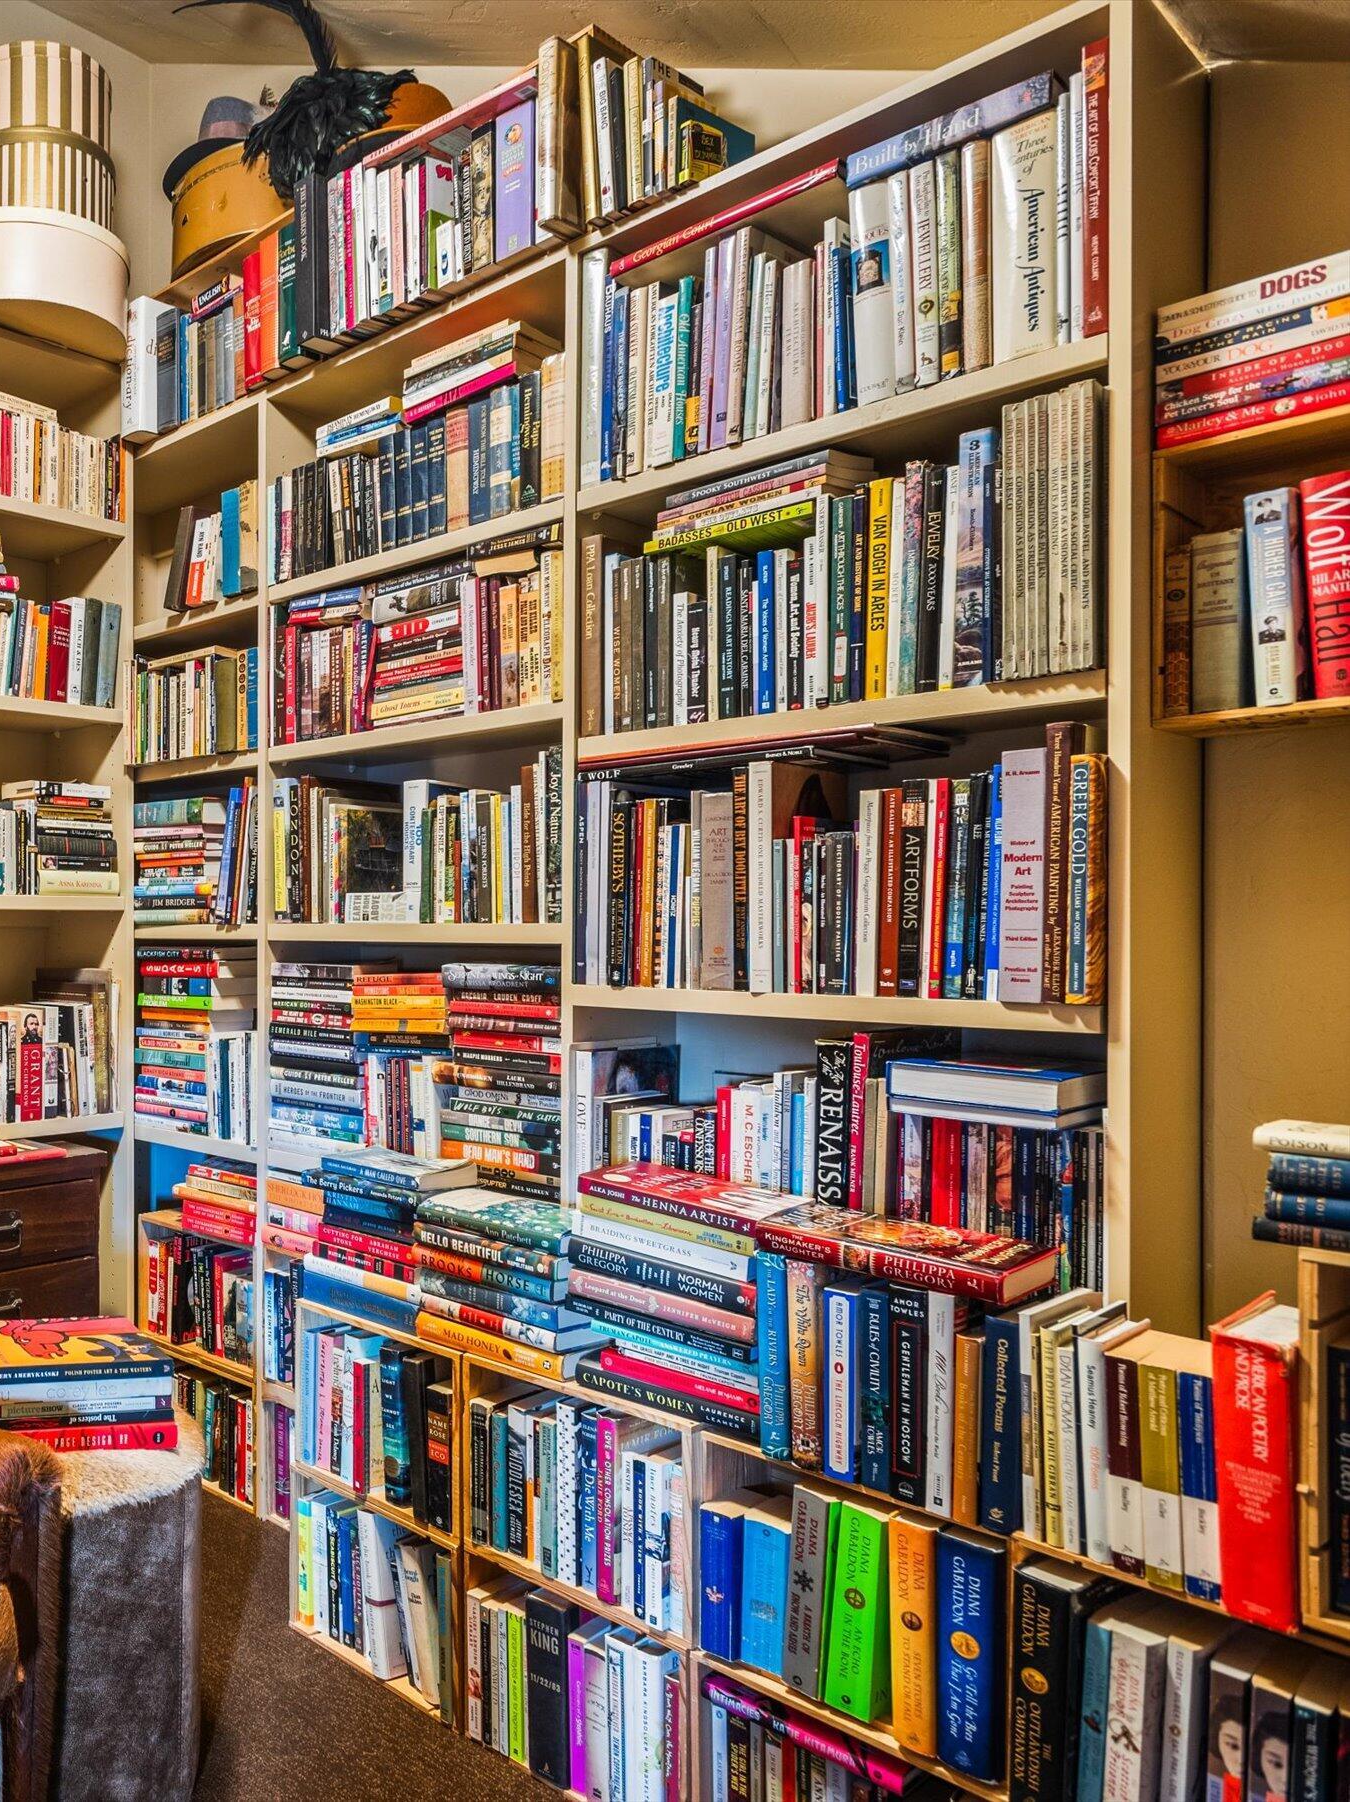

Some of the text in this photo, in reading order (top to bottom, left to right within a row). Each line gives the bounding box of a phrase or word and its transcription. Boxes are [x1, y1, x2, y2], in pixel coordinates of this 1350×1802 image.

[599, 91, 608, 130] BIG BANG
[854, 109, 980, 176] Built by Hand
[1016, 136, 1047, 153] Three
[1022, 165, 1034, 175] of
[632, 215, 715, 263] Georgian Court
[916, 215, 932, 292] JEWELLERY
[1015, 180, 1045, 332] American Antiques
[1260, 264, 1327, 299] DOGS
[656, 304, 675, 394] Architecture
[1211, 364, 1261, 381] INSIDE
[1269, 356, 1286, 365] OF
[1311, 341, 1345, 355] DOG
[1164, 382, 1261, 411] Chicken Soup for the
[1164, 396, 1238, 419] Pet Lover's Soul
[1175, 405, 1265, 433] Marley & Me
[691, 472, 771, 499] SPOOKY SOUTHWEST
[658, 510, 782, 550] BADASSES OLD WEST
[870, 514, 887, 632] VAN GOGH IN ARLES
[1263, 526, 1288, 612] A HIGHER CALL
[1314, 599, 1350, 664] Hall
[588, 770, 621, 780] WOLF
[550, 772, 562, 844] Joy of Nature
[1072, 768, 1088, 875] GREEK GOLD
[290, 790, 298, 876] LONDON
[612, 812, 625, 892] SOTHEBY'S
[1004, 853, 1042, 862] Modern
[903, 834, 920, 929] ARTFORMS
[1014, 866, 1031, 876] Art
[152, 897, 196, 909] JIM BRIDGER
[146, 965, 201, 973] SEDARIS
[30, 1049, 41, 1107] GRANT
[1268, 1136, 1329, 1151] POISON
[306, 1174, 364, 1194] The Berry Pickers
[589, 1186, 625, 1198] ALKA JOSHI
[322, 1227, 363, 1243] CUTTING FOR
[368, 1239, 399, 1253] ABRAHAM
[420, 1230, 504, 1263] HELLO BEAUTIFUL
[484, 1226, 532, 1246] Ann Patchett
[765, 1232, 831, 1254] KINGMAKER'S
[771, 1241, 825, 1260] DAUGHTER
[368, 1246, 400, 1260] VERGHESE
[421, 1254, 472, 1278] BROOKS
[578, 1254, 628, 1275] GREGORY
[581, 1244, 627, 1266] PHILIPPA
[884, 1255, 956, 1279] PHILIPPA
[486, 1268, 530, 1292] HORSE
[677, 1273, 725, 1294] NORMAL
[678, 1282, 724, 1303] WOMEN
[883, 1268, 954, 1290] GREGORY
[443, 1328, 500, 1354] MAD HONEY
[604, 1310, 685, 1342] PARTY OF THE CENTURY
[582, 1373, 694, 1413] CAPOTE'S WOMEN
[994, 1339, 1008, 1433] Collected Poems
[509, 1447, 524, 1514] MIDDLESEX
[795, 1501, 806, 1563] GABALDON
[807, 1518, 818, 1557] DIANA
[847, 1518, 858, 1582] GABALDON
[858, 1536, 870, 1574] DIANA
[897, 1533, 908, 1601] GABALDON
[913, 1553, 925, 1590] DIANA
[951, 1555, 966, 1626] GABALDON
[967, 1575, 980, 1616] DIANA
[529, 1618, 559, 1636] STEPHEN
[1020, 1584, 1036, 1657] GABALDON
[1036, 1604, 1050, 1648] DIANA
[530, 1629, 559, 1656] KING
[530, 1672, 562, 1694] 11/22/63
[708, 1690, 761, 1721] INTIMACIES
[772, 1719, 858, 1767] KATIE KITAMURA
[1014, 1697, 1027, 1779] COMPANION
[1027, 1702, 1041, 1792] OUTLANDISH
